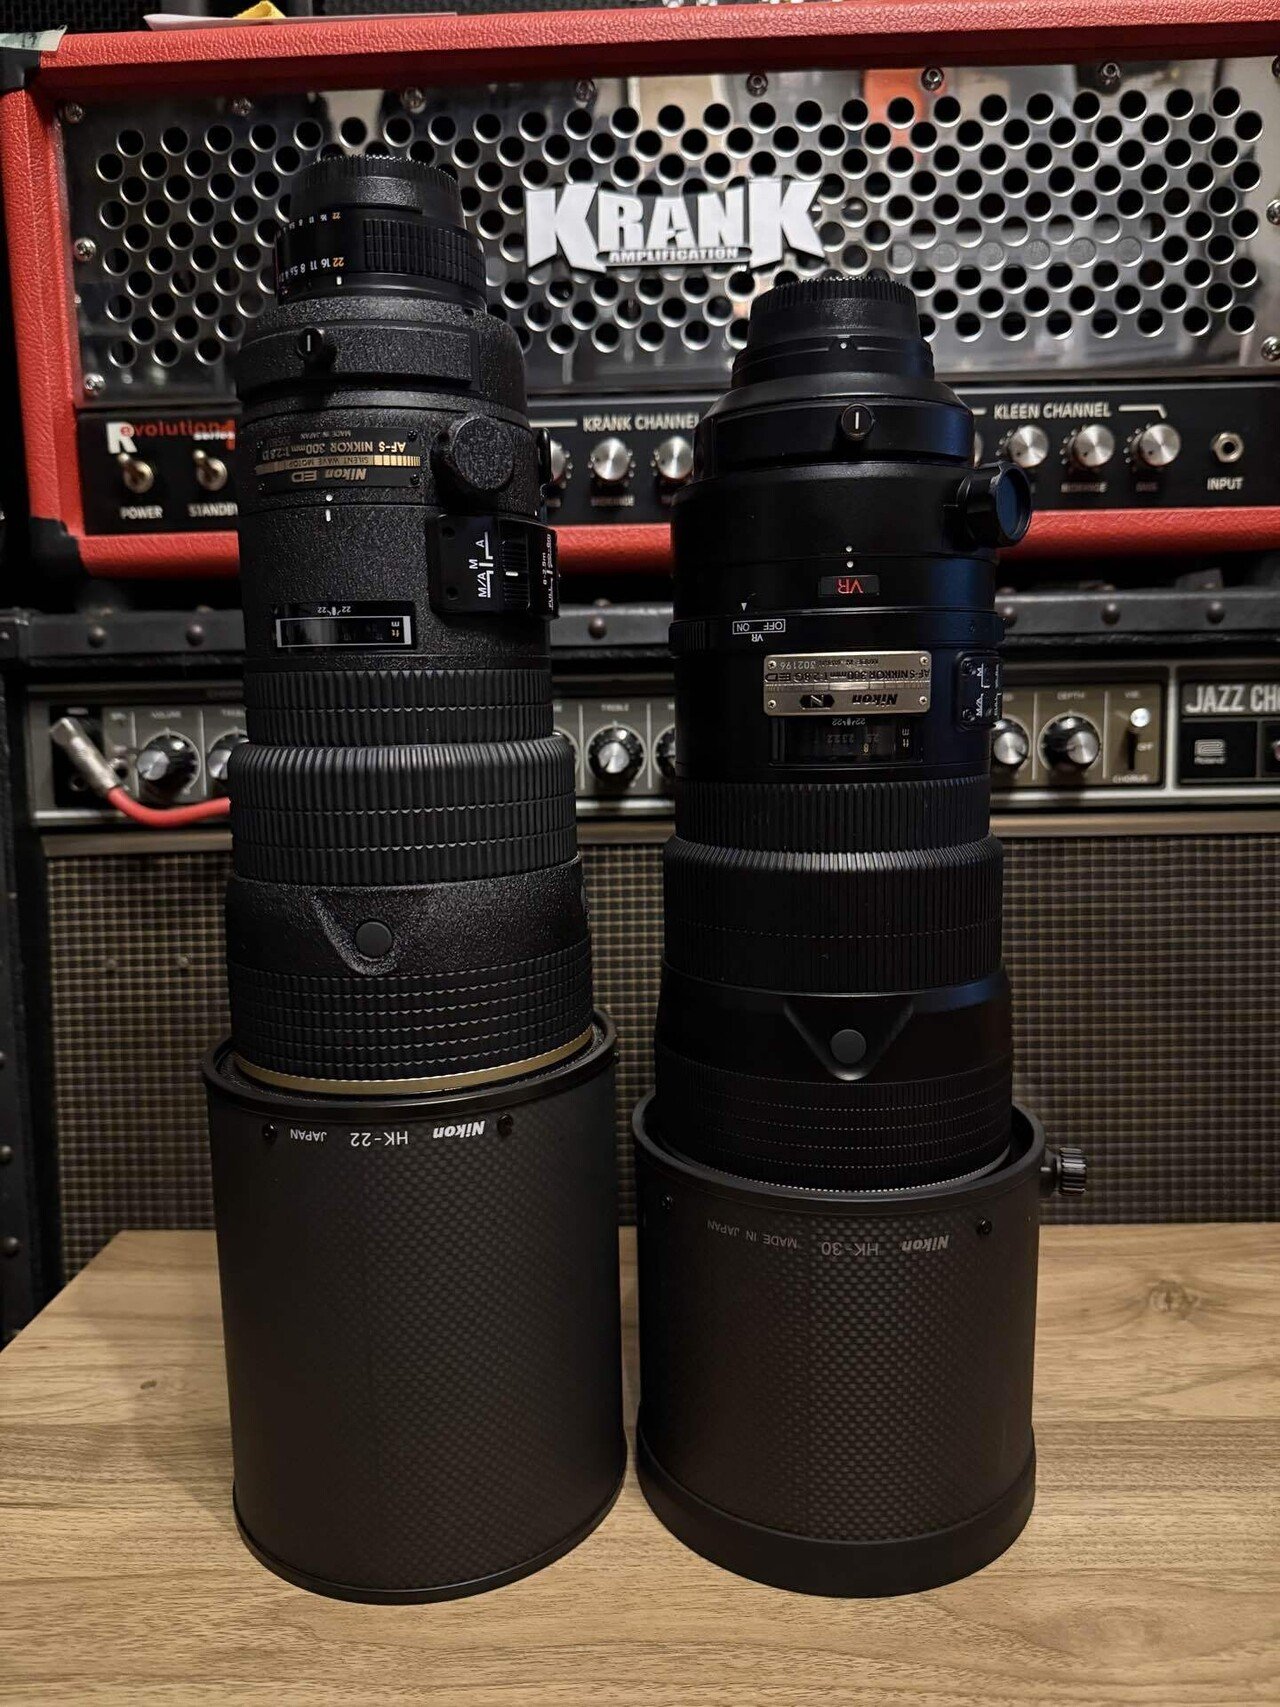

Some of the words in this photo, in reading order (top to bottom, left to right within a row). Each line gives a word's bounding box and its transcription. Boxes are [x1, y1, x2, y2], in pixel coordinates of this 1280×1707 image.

[525, 182, 826, 273] KRANK
[609, 248, 738, 263] AMPLIFICATION
[300, 263, 306, 274] 8
[310, 260, 318, 271] 11
[321, 258, 331, 268] 16
[332, 257, 344, 268] 22
[994, 403, 1040, 420] KLEEN
[1043, 402, 1112, 419] CHANNEL
[583, 415, 632, 432] KRANK
[330, 441, 373, 453] NIKKOR
[378, 441, 406, 453] AF-S
[343, 456, 369, 465] SILENT
[291, 470, 317, 483] ED
[325, 468, 367, 481] Nikon
[1207, 477, 1244, 490] INPUT
[120, 505, 163, 519] POWER
[475, 539, 485, 548] A
[468, 559, 478, 569] M
[477, 572, 487, 598] M/A
[837, 578, 864, 594] VR
[736, 623, 750, 632] ON
[763, 621, 783, 631] OFF
[751, 633, 764, 643] VR
[869, 669, 909, 680] NIKKOR
[910, 669, 930, 679] AF-S
[852, 693, 899, 706] Nikon
[1185, 684, 1246, 713] JAZZ
[290, 1128, 327, 1142] JAPAN
[432, 1120, 486, 1139] Nikon
[350, 1131, 409, 1147] HK-22
[706, 1219, 740, 1237] JAPAN
[745, 1232, 757, 1242] IN
[762, 1233, 798, 1249] MADE
[901, 1234, 951, 1252] Nikon
[820, 1241, 879, 1256] HK-30
